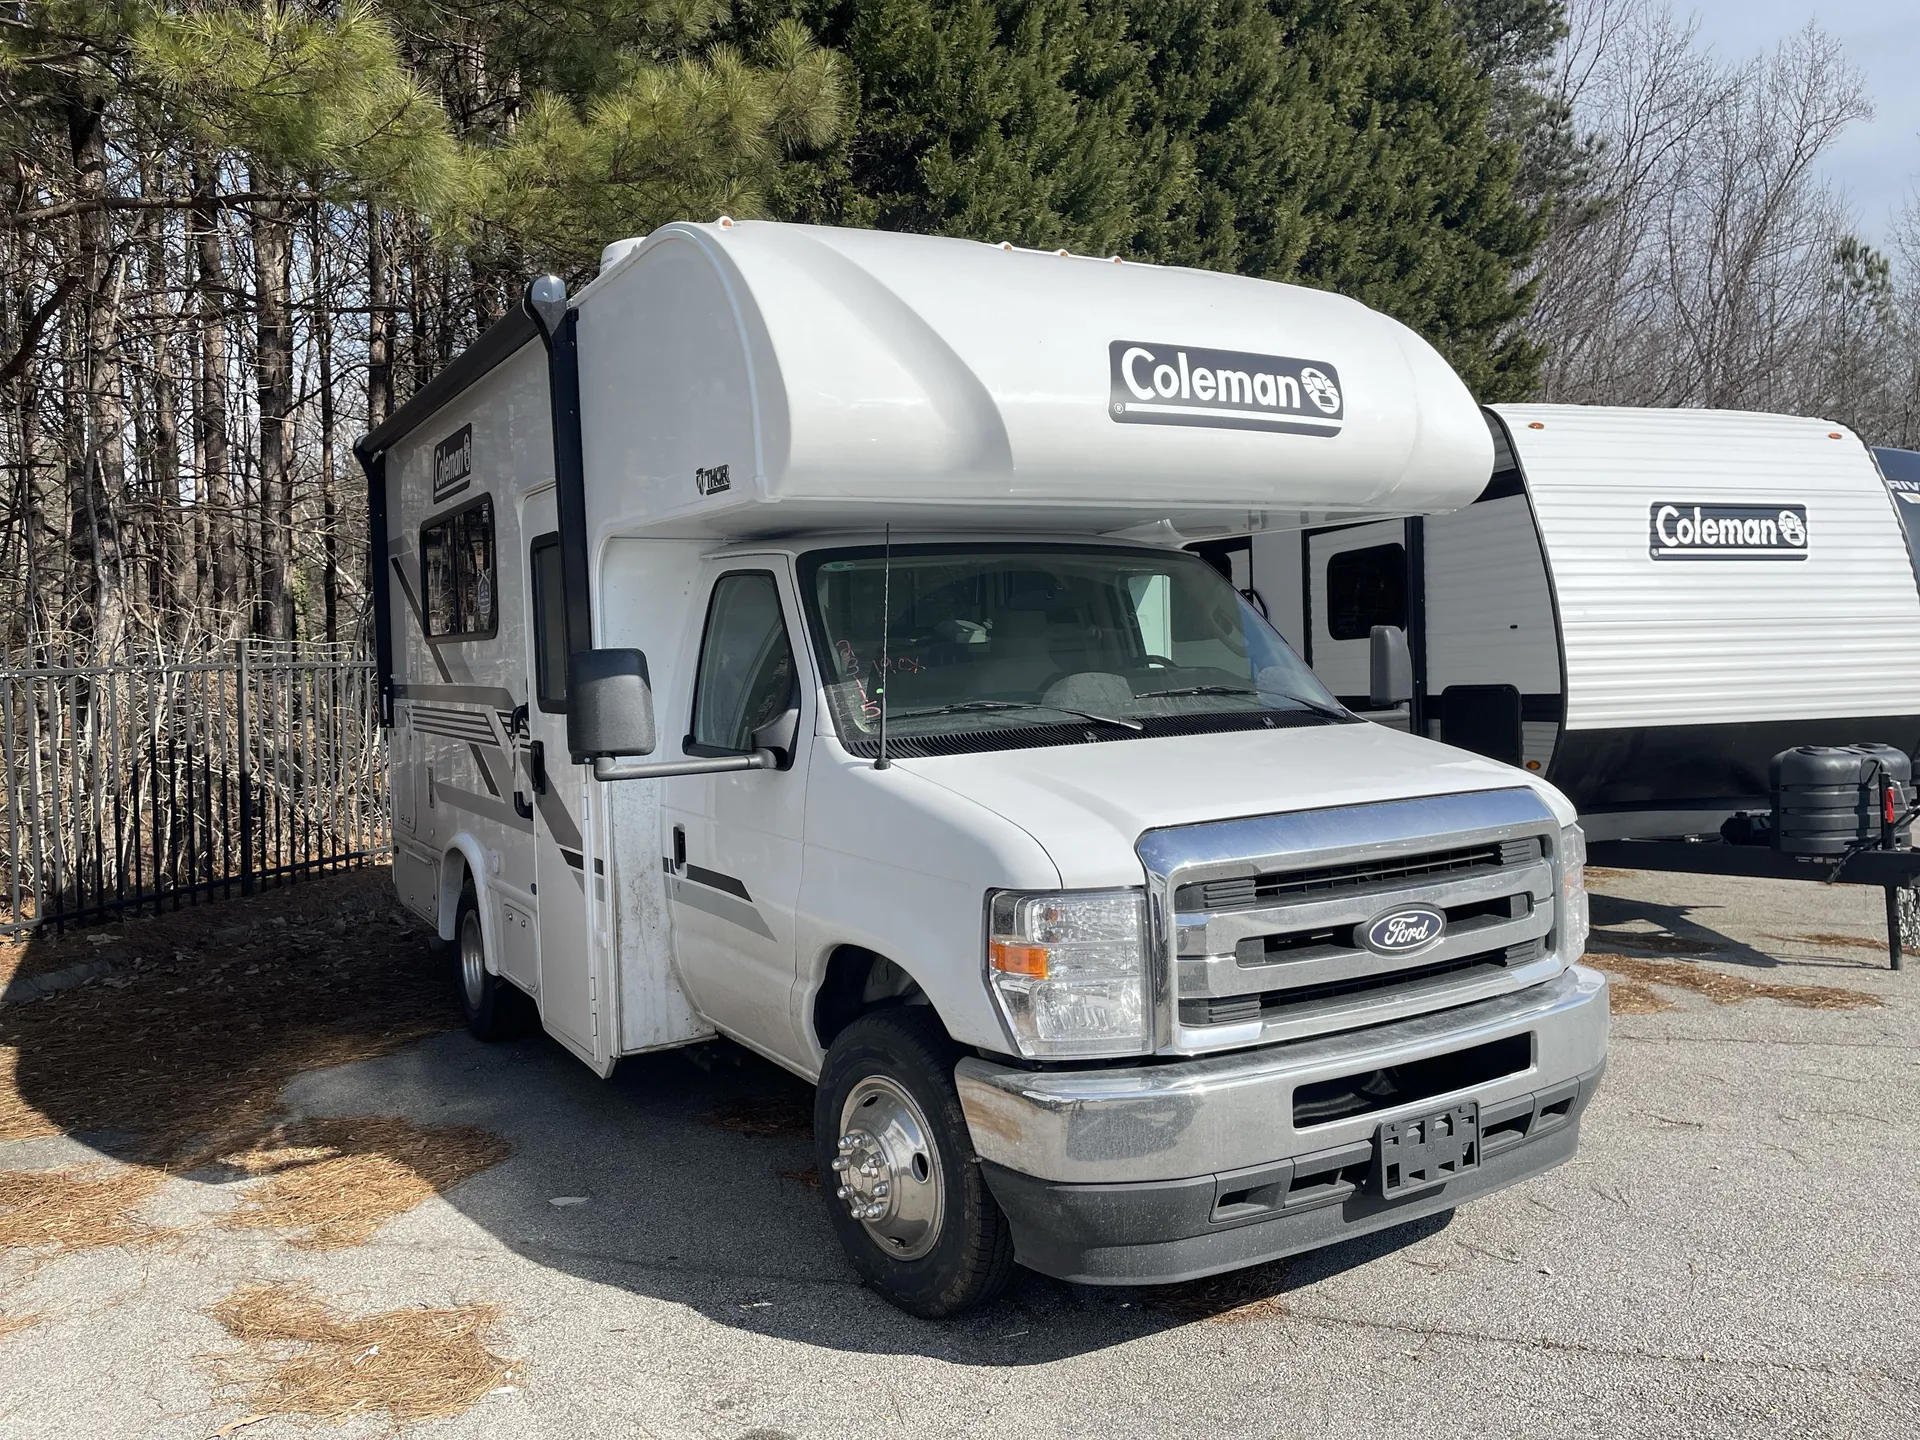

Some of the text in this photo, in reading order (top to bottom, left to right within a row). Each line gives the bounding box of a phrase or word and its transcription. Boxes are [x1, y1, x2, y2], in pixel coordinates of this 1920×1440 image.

[1121, 346, 1301, 409] Coleman
[434, 445, 464, 490] Coleman
[704, 464, 731, 489] THOR
[1886, 480, 1920, 491] RIV
[1655, 505, 1778, 548] Coleman
[1384, 915, 1430, 946] Ford
